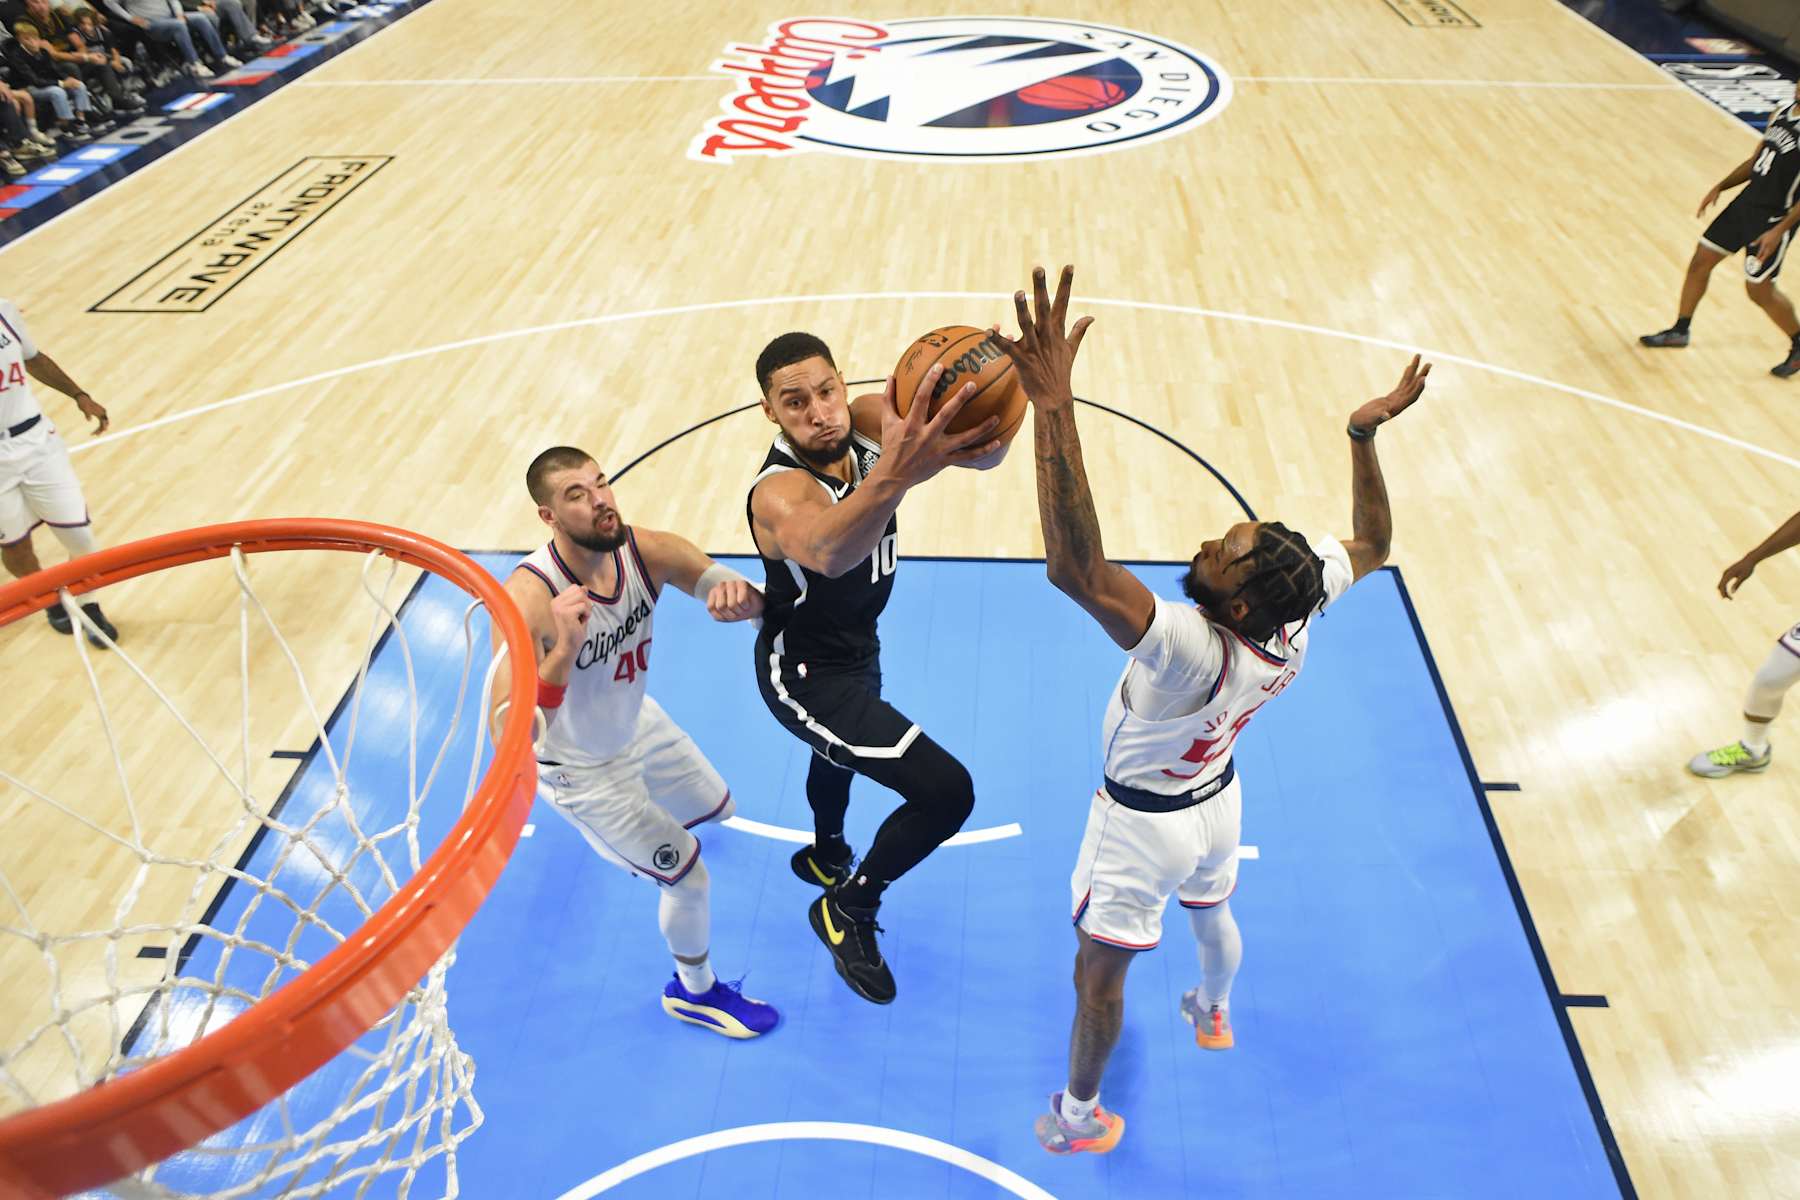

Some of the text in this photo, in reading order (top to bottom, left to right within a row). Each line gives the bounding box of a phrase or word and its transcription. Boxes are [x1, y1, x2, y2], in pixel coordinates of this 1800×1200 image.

[701, 20, 889, 157] Clippers
[1075, 32, 1190, 133] SAN DIEGO
[158, 161, 367, 303] FRONTWAVE
[202, 202, 272, 248] arena
[871, 532, 898, 584] 10
[575, 598, 651, 671] Clippers
